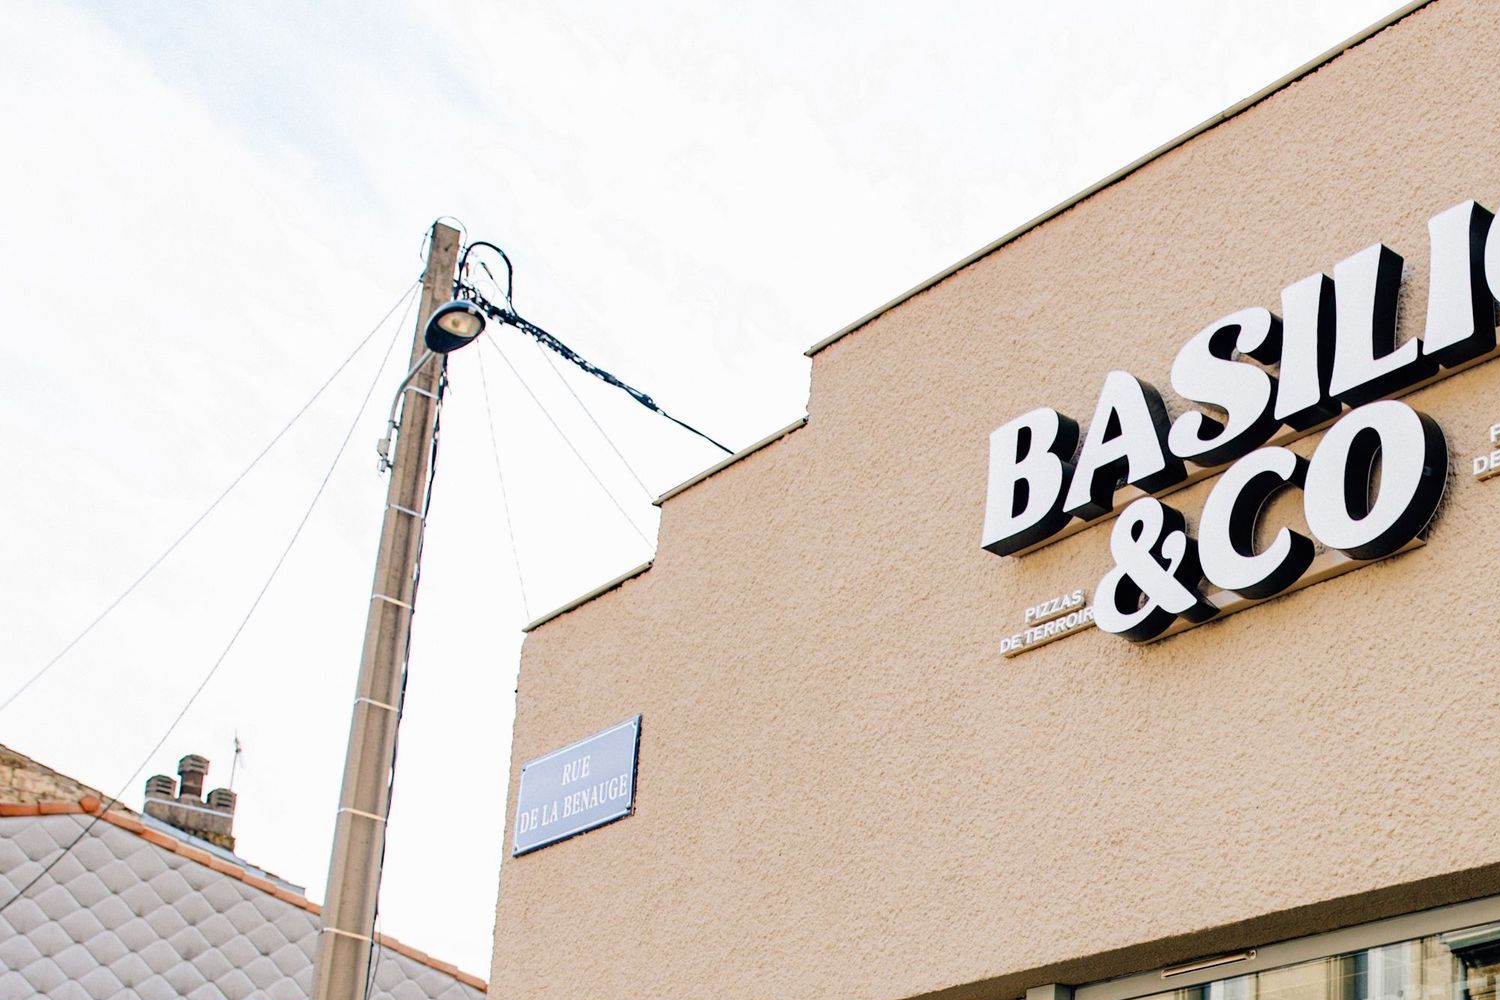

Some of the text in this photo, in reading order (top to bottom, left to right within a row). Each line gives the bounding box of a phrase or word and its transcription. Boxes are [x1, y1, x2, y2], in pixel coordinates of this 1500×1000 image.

[1024, 589, 1085, 624] PIZZAS
[1000, 634, 1024, 654] DE
[561, 755, 591, 786] RUE
[519, 773, 628, 834] DE LA BENAUGE
